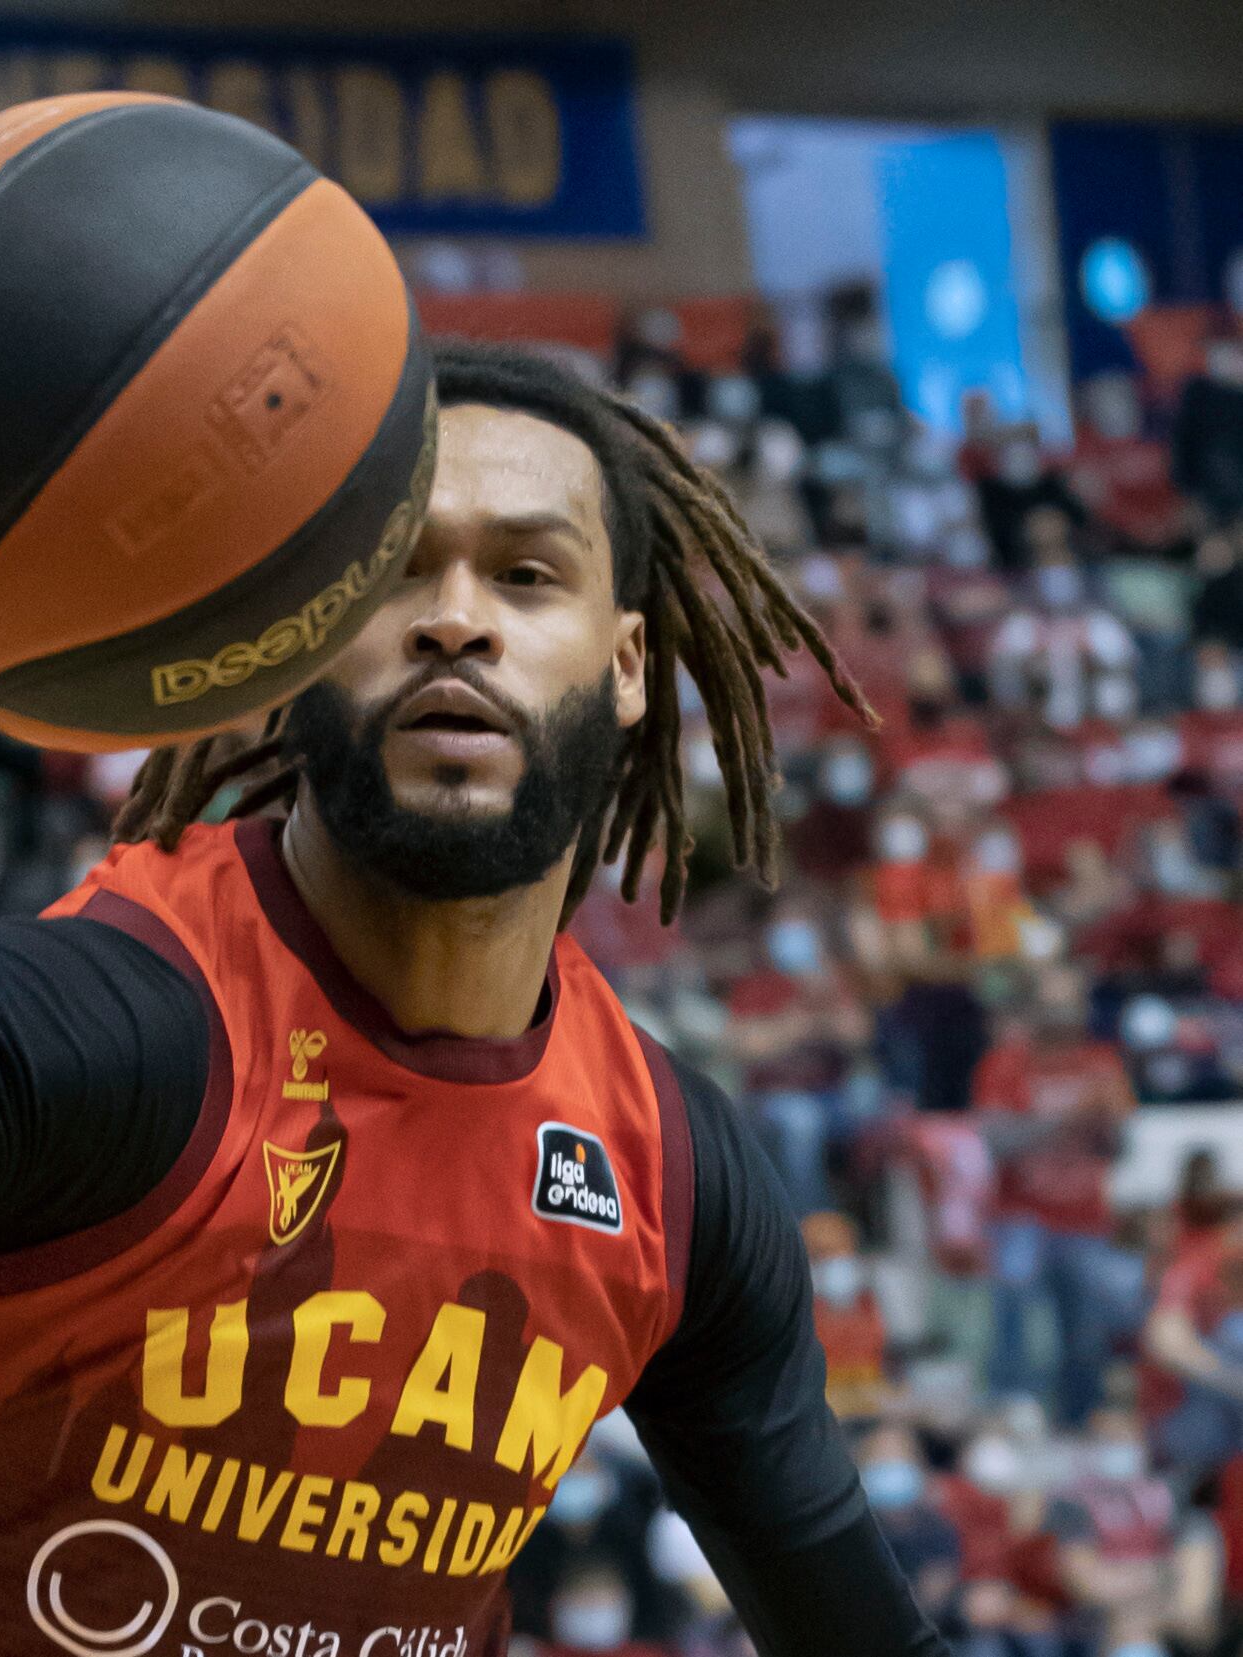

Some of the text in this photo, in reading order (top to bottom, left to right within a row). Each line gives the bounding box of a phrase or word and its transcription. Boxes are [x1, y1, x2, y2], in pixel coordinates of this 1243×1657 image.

[550, 1151, 586, 1186] liga
[142, 1290, 608, 1490] UCAM
[188, 1596, 341, 1657] Costa
